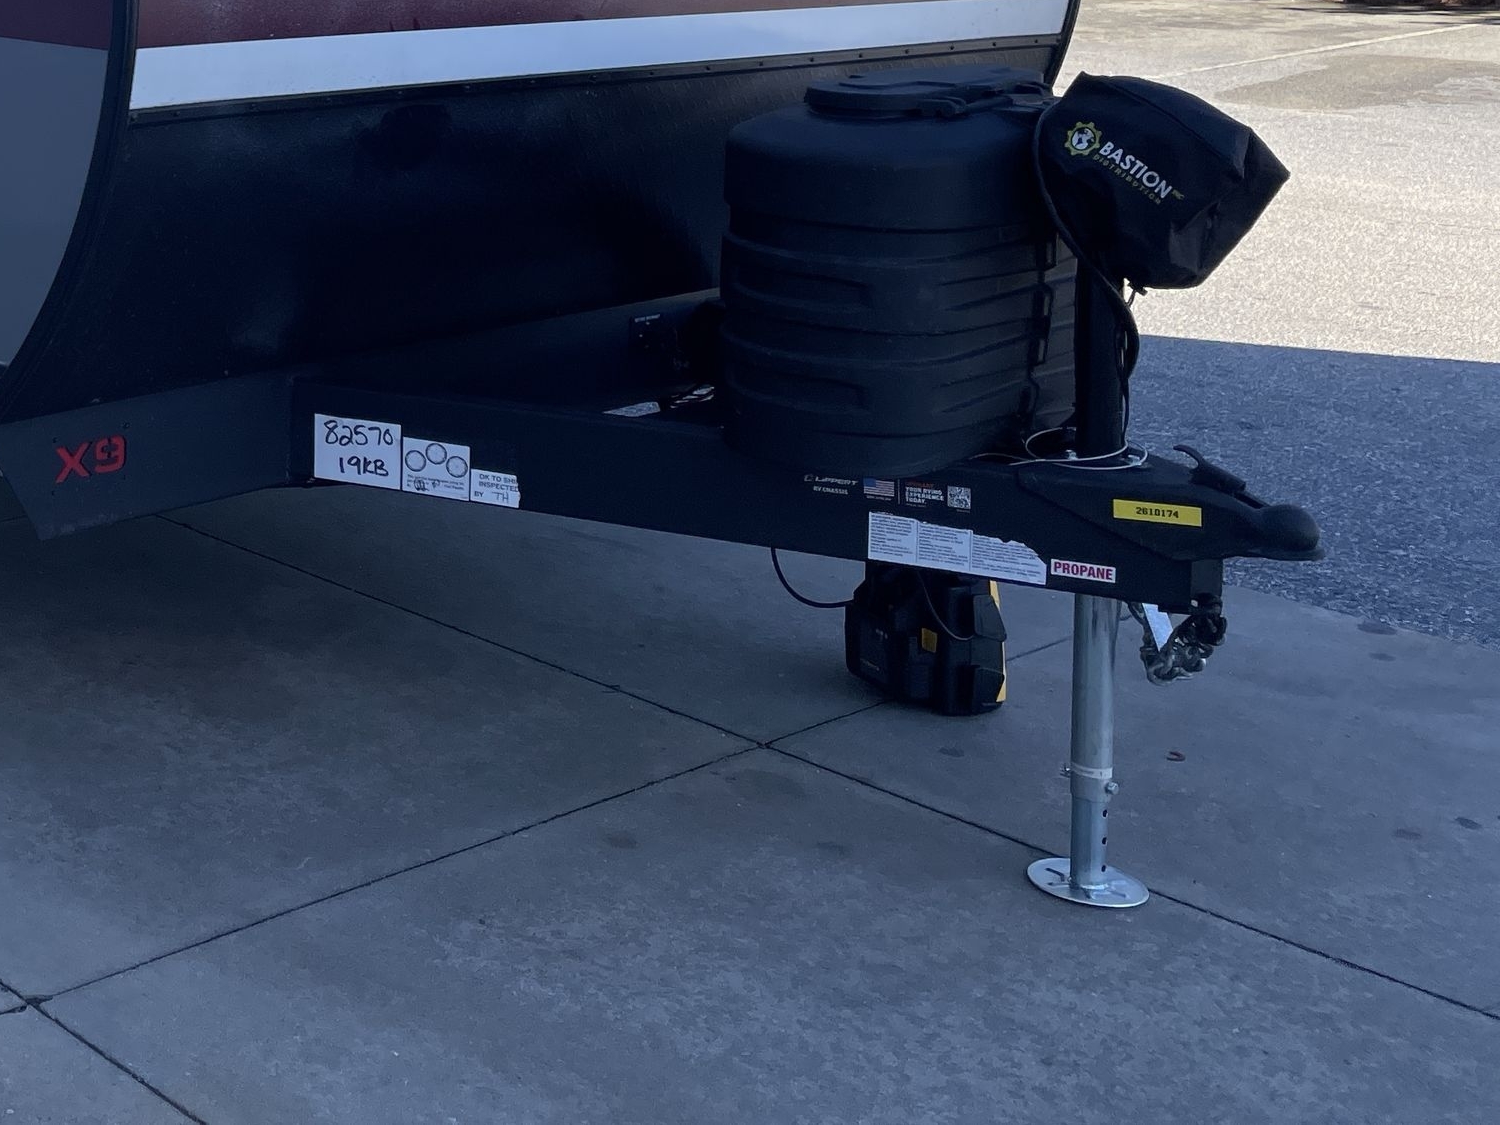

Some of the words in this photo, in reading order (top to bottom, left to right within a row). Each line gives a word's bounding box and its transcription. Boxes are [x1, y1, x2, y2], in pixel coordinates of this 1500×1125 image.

[1100, 141, 1173, 199] BASTION
[323, 420, 393, 446] 82570
[55, 435, 127, 485] X9
[491, 475, 502, 483] TO
[474, 490, 485, 498] BY
[1135, 506, 1179, 519] 2610174
[1053, 561, 1114, 581] PROPANE
